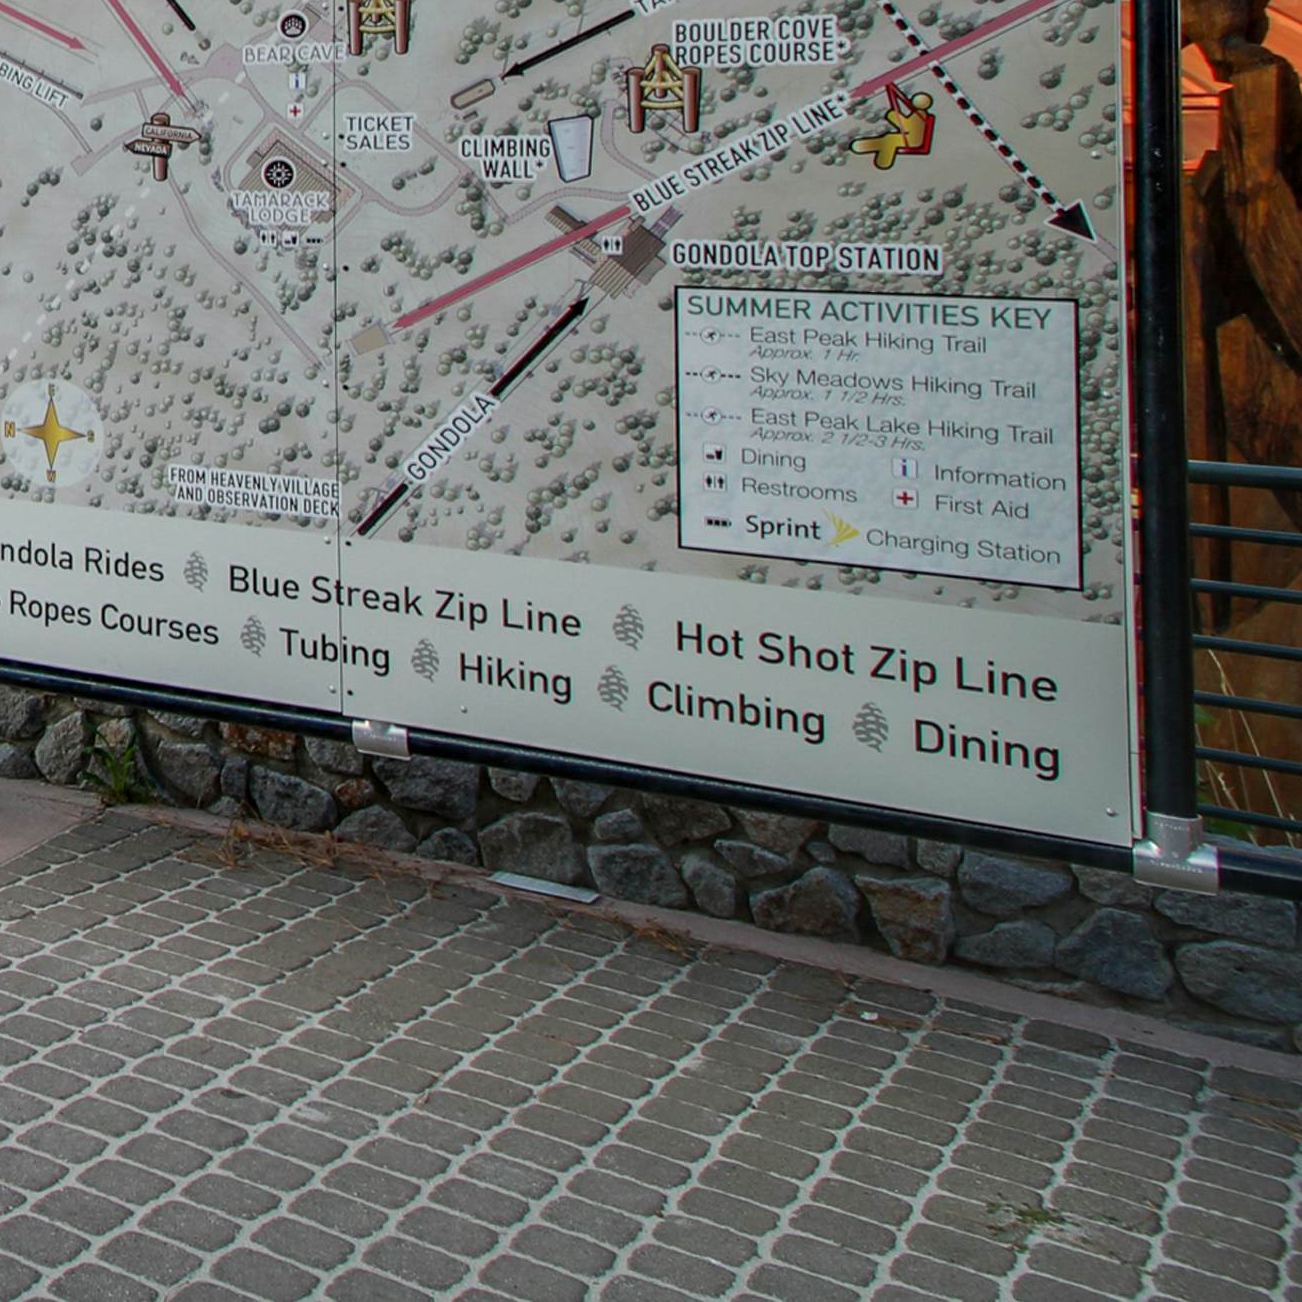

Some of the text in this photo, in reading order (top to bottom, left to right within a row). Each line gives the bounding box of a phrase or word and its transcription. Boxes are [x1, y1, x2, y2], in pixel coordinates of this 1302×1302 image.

[675, 18, 833, 43] BOULDER COVE
[245, 45, 342, 63] BEAR CAVE
[675, 44, 742, 65] ROPES
[36, 85, 68, 107] LIFT
[144, 127, 194, 141] CALIFORNIA
[347, 116, 413, 132] TICKET
[134, 144, 168, 154] NEVADA
[347, 134, 411, 149] SALES
[461, 138, 551, 158] CLIMBING
[633, 176, 685, 212] BLUE
[684, 138, 754, 188] STREAK
[759, 126, 789, 154] ZIP
[232, 192, 329, 208] TAMARACK
[249, 208, 310, 223] LODGE
[673, 243, 939, 271] GONDOLA TOP STATION
[687, 295, 1052, 330] SUMMER ACTIVITIES KEY
[750, 326, 986, 355] East Peak Hiking Trail
[749, 346, 860, 362] Approx. 1 Hr.
[750, 366, 1036, 400] Sky Meadows Hiking Trail
[750, 385, 906, 407] Approx. 1 1/2 Hrs.
[4, 421, 15, 438] N
[407, 394, 496, 482] GONDOLA
[750, 426, 926, 451] Approx. 2 1/2-3 Hrs.
[751, 407, 1053, 445] East Peak Lake Hiking Trail
[741, 448, 806, 473] Dining
[170, 467, 339, 498] FROM HEAVENLY VILLAGE
[741, 477, 858, 503] Restrooms
[935, 464, 1066, 491] Information
[177, 486, 339, 517] AND OBSERVATION DECK
[935, 494, 1029, 519] First Aid
[746, 514, 1061, 564] Sprint Charging Station
[85, 547, 165, 582] Rides
[229, 565, 300, 600] Blue
[311, 575, 423, 617] Streak
[435, 590, 488, 631] Zip
[502, 598, 581, 637] Line
[676, 620, 744, 660] Hot
[758, 631, 855, 675] Shot
[869, 645, 937, 694] Zip
[955, 656, 1058, 702] Line
[10, 590, 92, 627] Ropes
[101, 603, 219, 645] Courses
[279, 627, 390, 677] Tubing
[459, 652, 572, 705] Hiking
[648, 680, 825, 745] Climbing
[914, 718, 1060, 782] Dining
